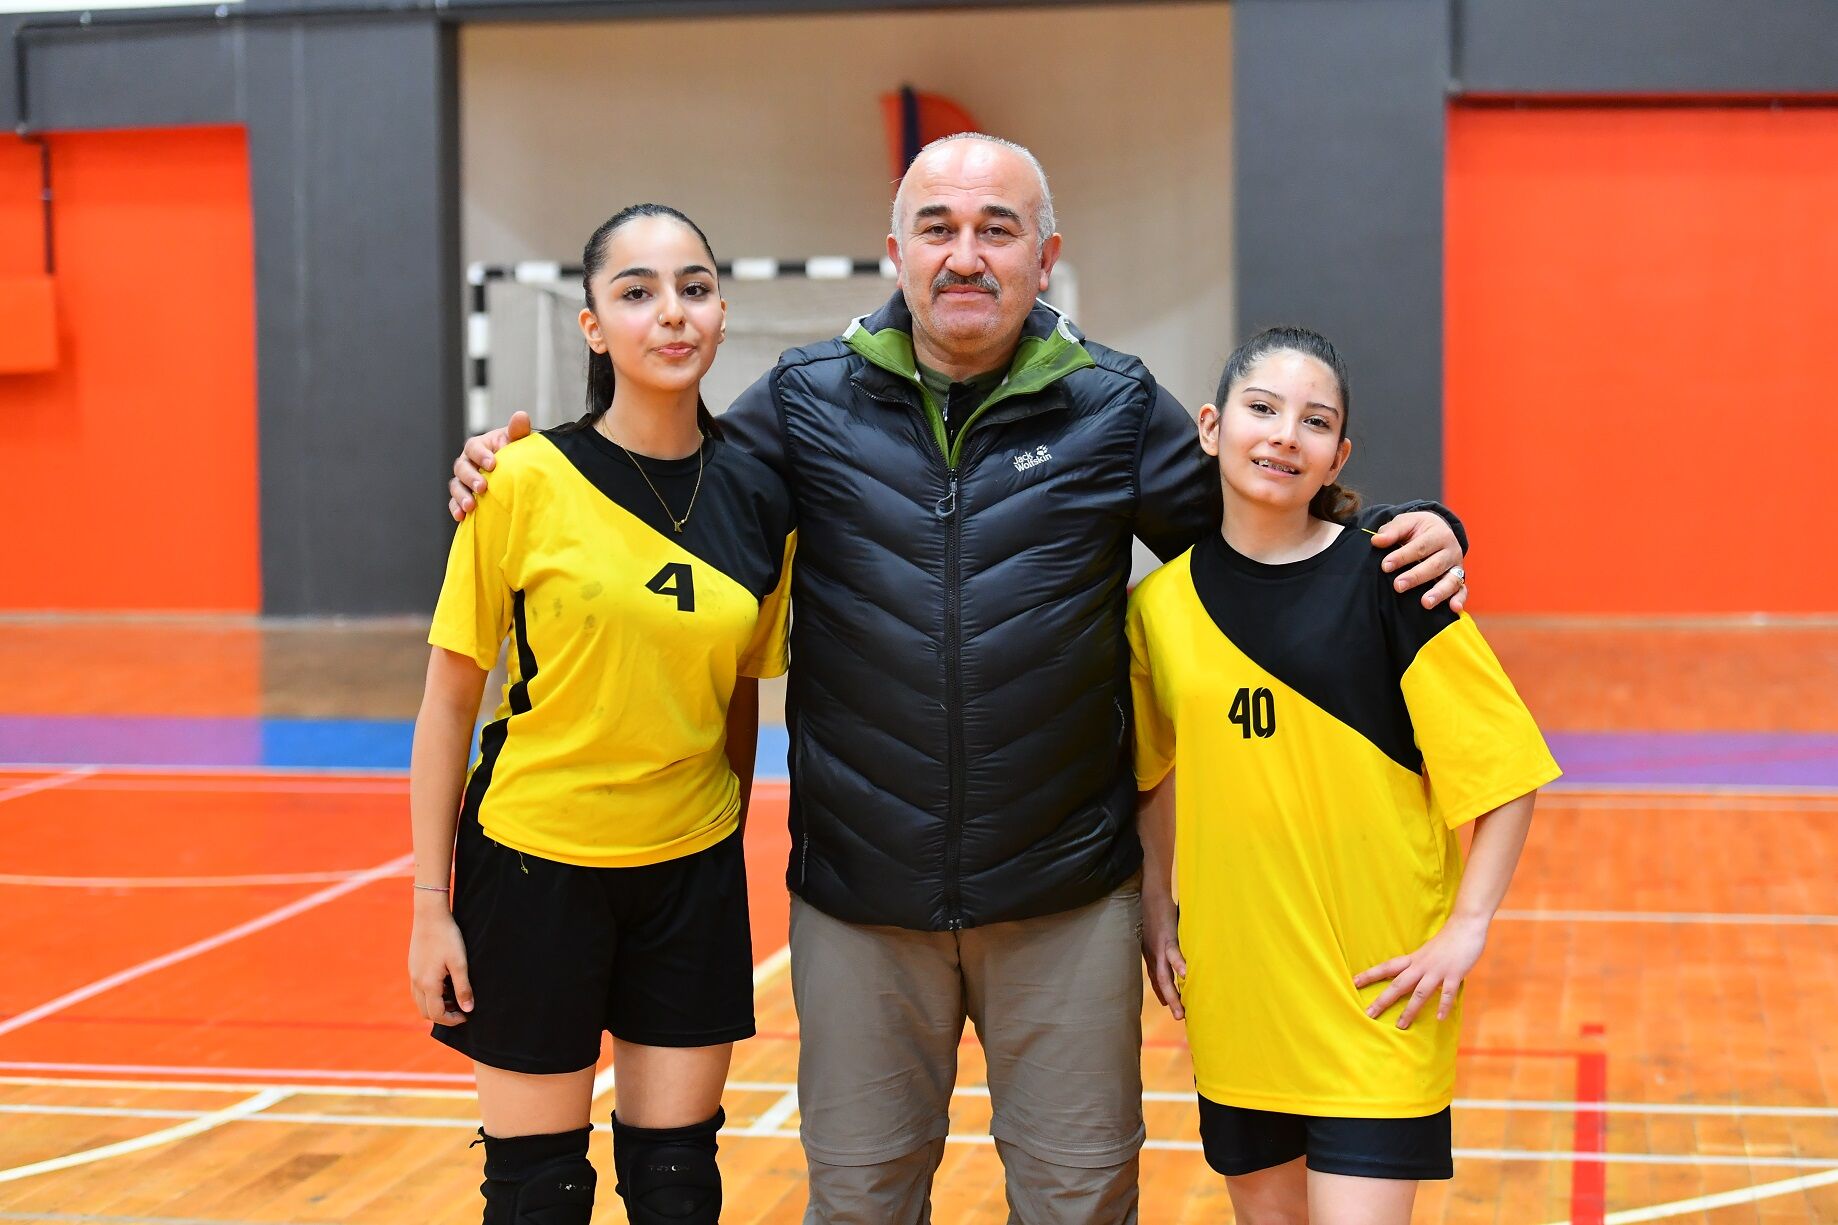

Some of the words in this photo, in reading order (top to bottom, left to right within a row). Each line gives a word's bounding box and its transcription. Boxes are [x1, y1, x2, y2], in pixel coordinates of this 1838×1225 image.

[1013, 451, 1033, 465] Jack
[1014, 453, 1053, 472] Wolfskin
[644, 562, 695, 613] 4
[1227, 687, 1276, 739] 40
